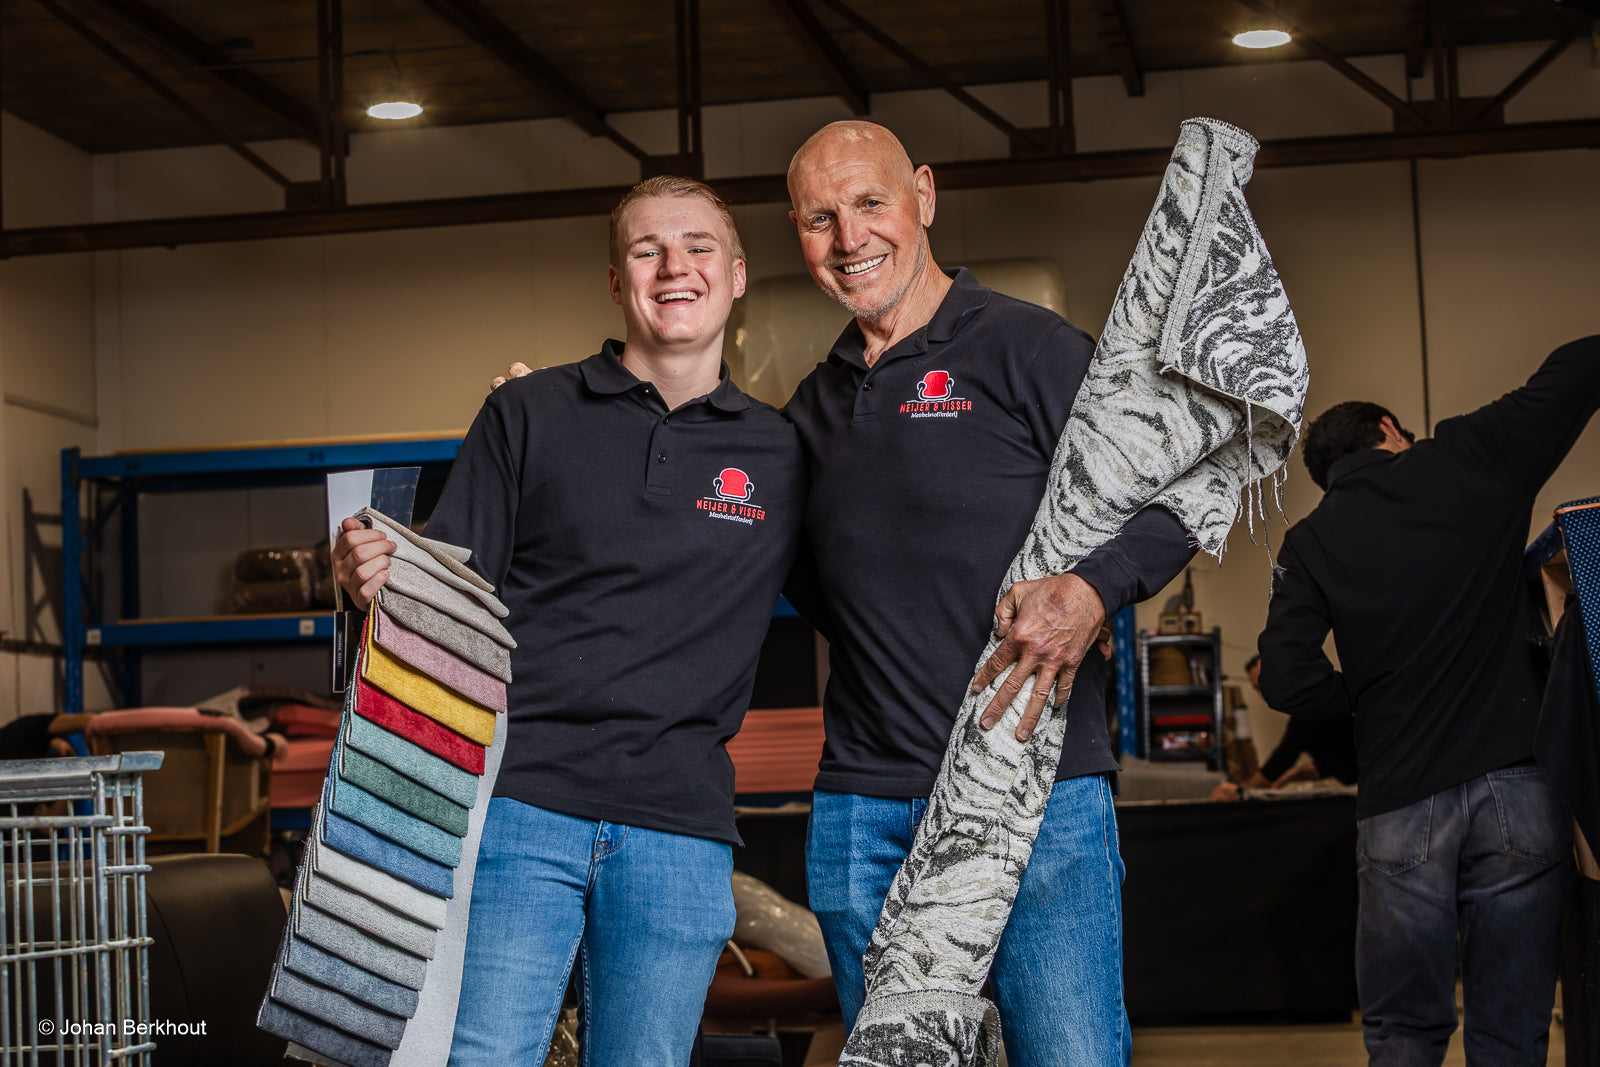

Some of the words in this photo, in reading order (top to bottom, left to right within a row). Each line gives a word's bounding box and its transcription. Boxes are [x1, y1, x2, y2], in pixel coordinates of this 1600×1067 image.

[933, 402, 939, 412] &
[941, 400, 973, 411] VISSER
[696, 499, 728, 513] MEIJER
[730, 504, 737, 514] &
[739, 505, 766, 520] VISSER
